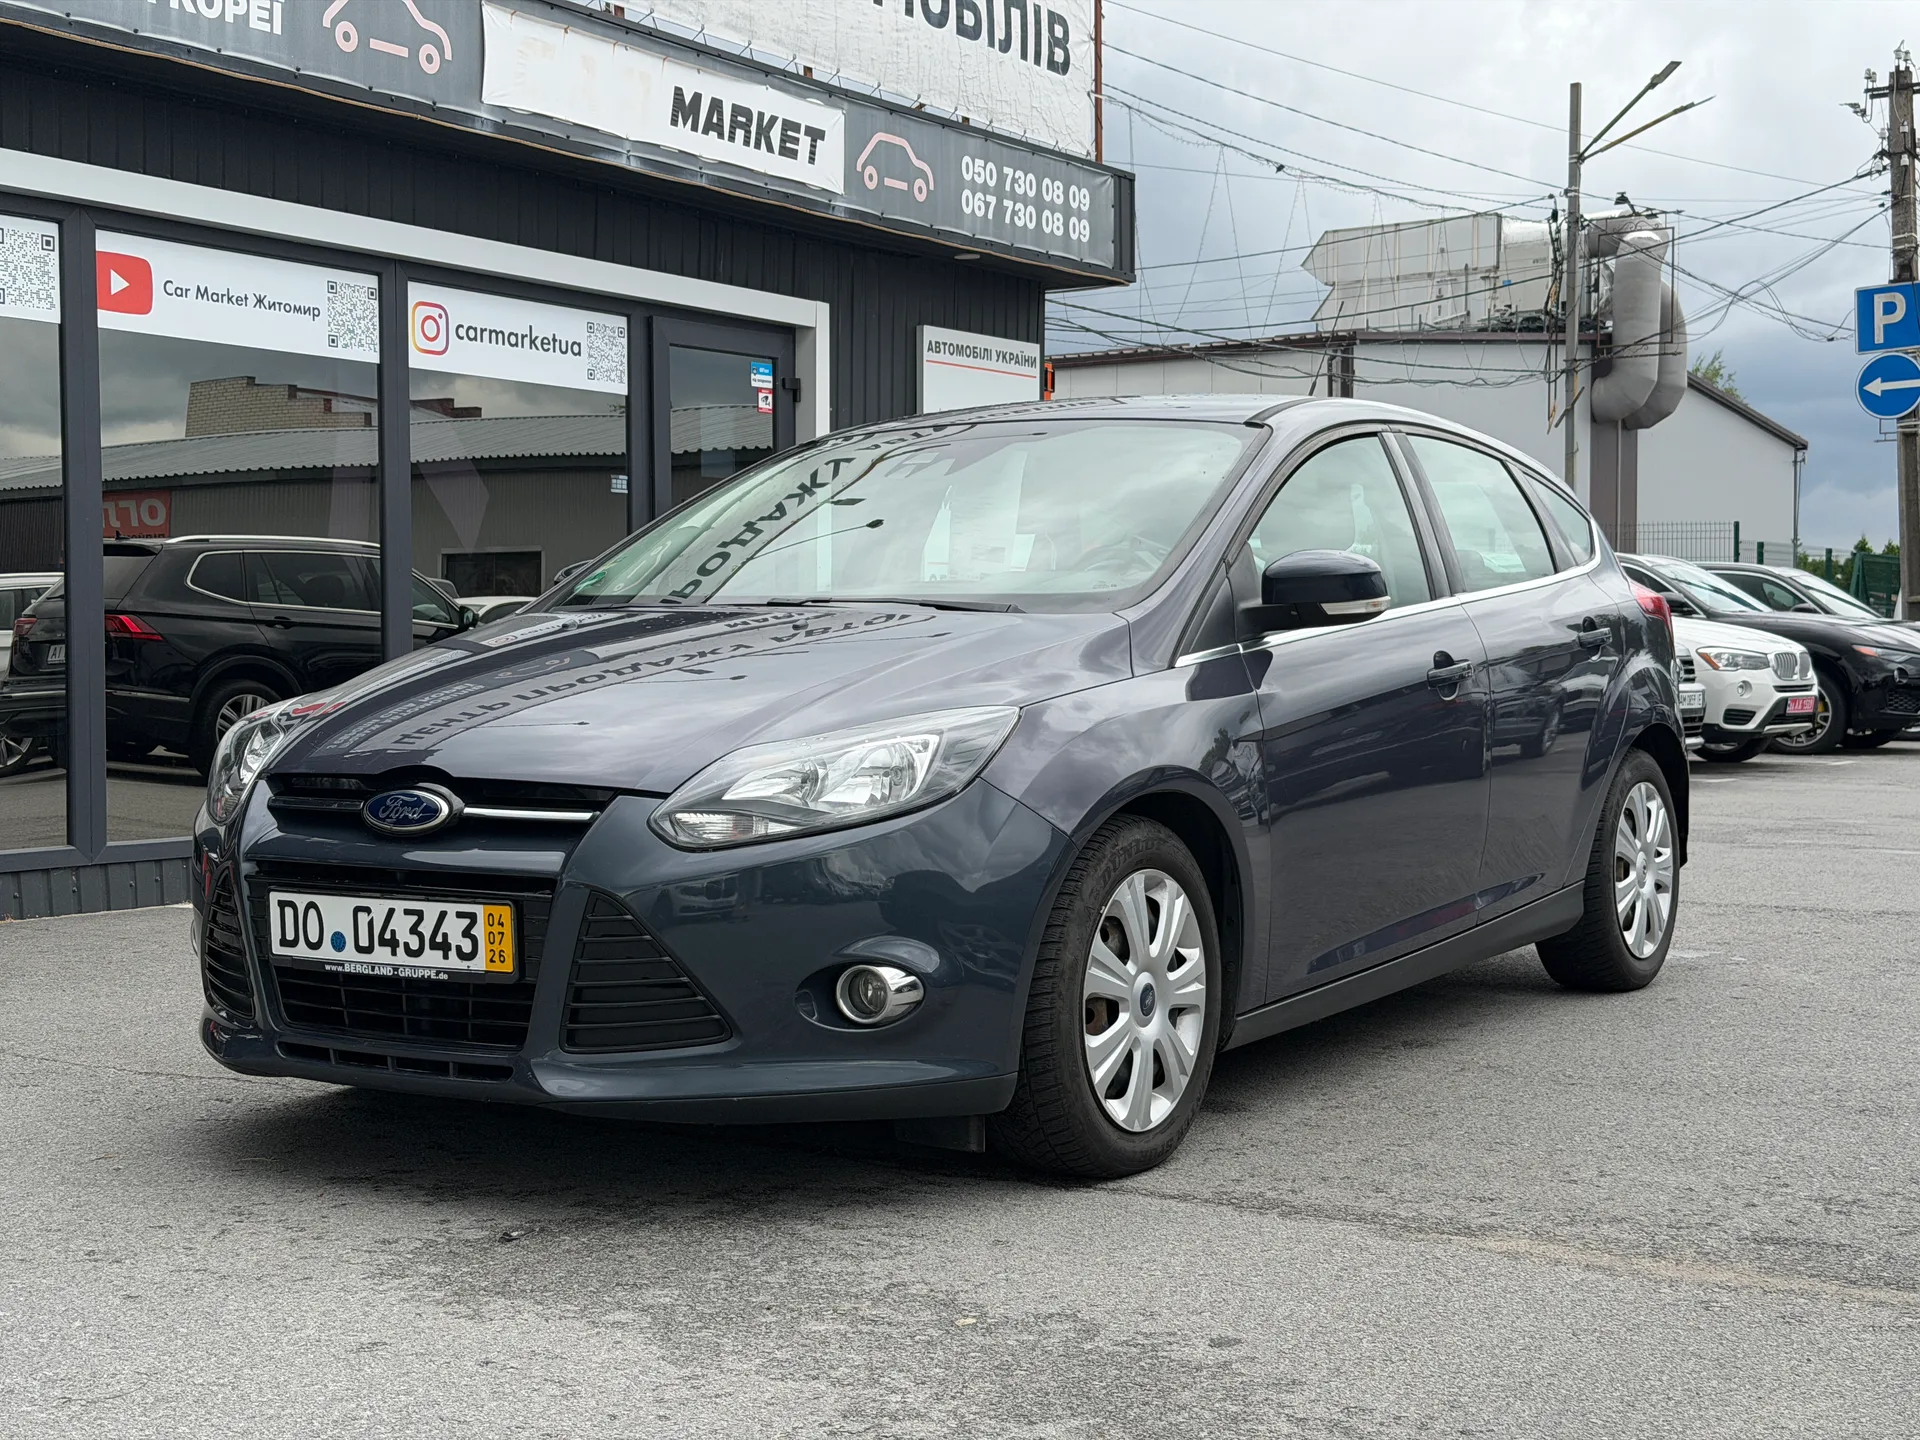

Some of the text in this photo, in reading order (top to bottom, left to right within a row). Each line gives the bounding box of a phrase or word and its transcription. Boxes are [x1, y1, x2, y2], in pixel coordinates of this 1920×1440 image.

[670, 86, 827, 165] MARKET
[961, 155, 1090, 212] 050 730 08 09
[961, 189, 1090, 243] 067 730 08 09
[163, 280, 321, 321] Car Market Житомир
[1873, 292, 1907, 345] P
[455, 320, 581, 357] carmarketua
[927, 339, 1037, 369] АВТОМОБІЛІ УКРАЇНИ
[378, 795, 433, 820] Ford
[277, 899, 479, 962] DO 04343
[487, 912, 505, 928] 04
[488, 931, 505, 946] 07
[489, 949, 506, 964] 26
